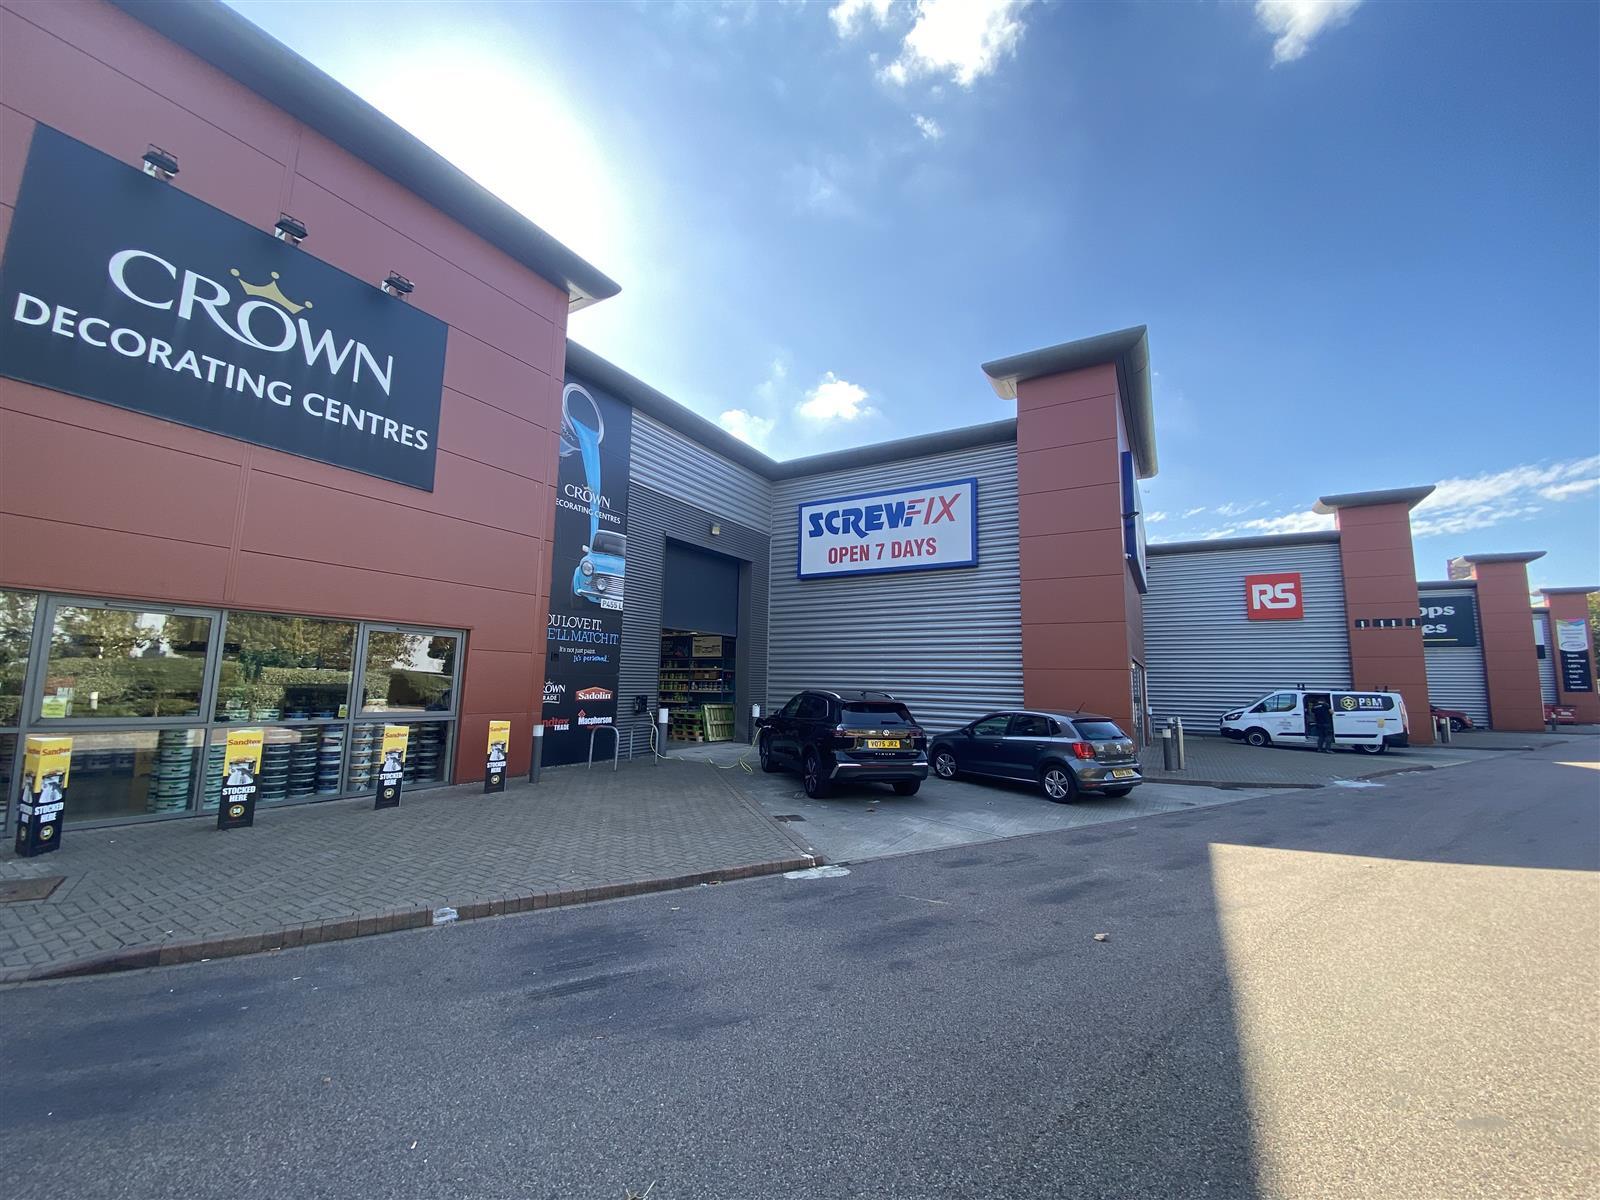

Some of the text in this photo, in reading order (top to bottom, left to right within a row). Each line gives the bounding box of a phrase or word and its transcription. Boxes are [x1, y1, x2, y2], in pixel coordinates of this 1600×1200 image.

[108, 249, 393, 396] CROWN
[14, 292, 428, 451] DECORATING CENTRES
[564, 483, 610, 509] CROWN
[556, 498, 621, 525] ECORATING CENTRES
[808, 492, 962, 539] SCREWFIX
[828, 537, 937, 565] OPEN 7 DAYS
[1251, 582, 1297, 609] RS
[547, 613, 560, 626] OU
[562, 615, 591, 629] LOVE
[1422, 624, 1448, 634] es
[547, 628, 569, 640] E'LL
[571, 630, 608, 644] MATCH
[543, 684, 566, 694] OWN
[578, 691, 611, 700] Sadolin
[543, 716, 570, 728] ndtex
[222, 785, 256, 795] STOCKED
[229, 794, 248, 802] HERE
[34, 802, 64, 816] STOCKED
